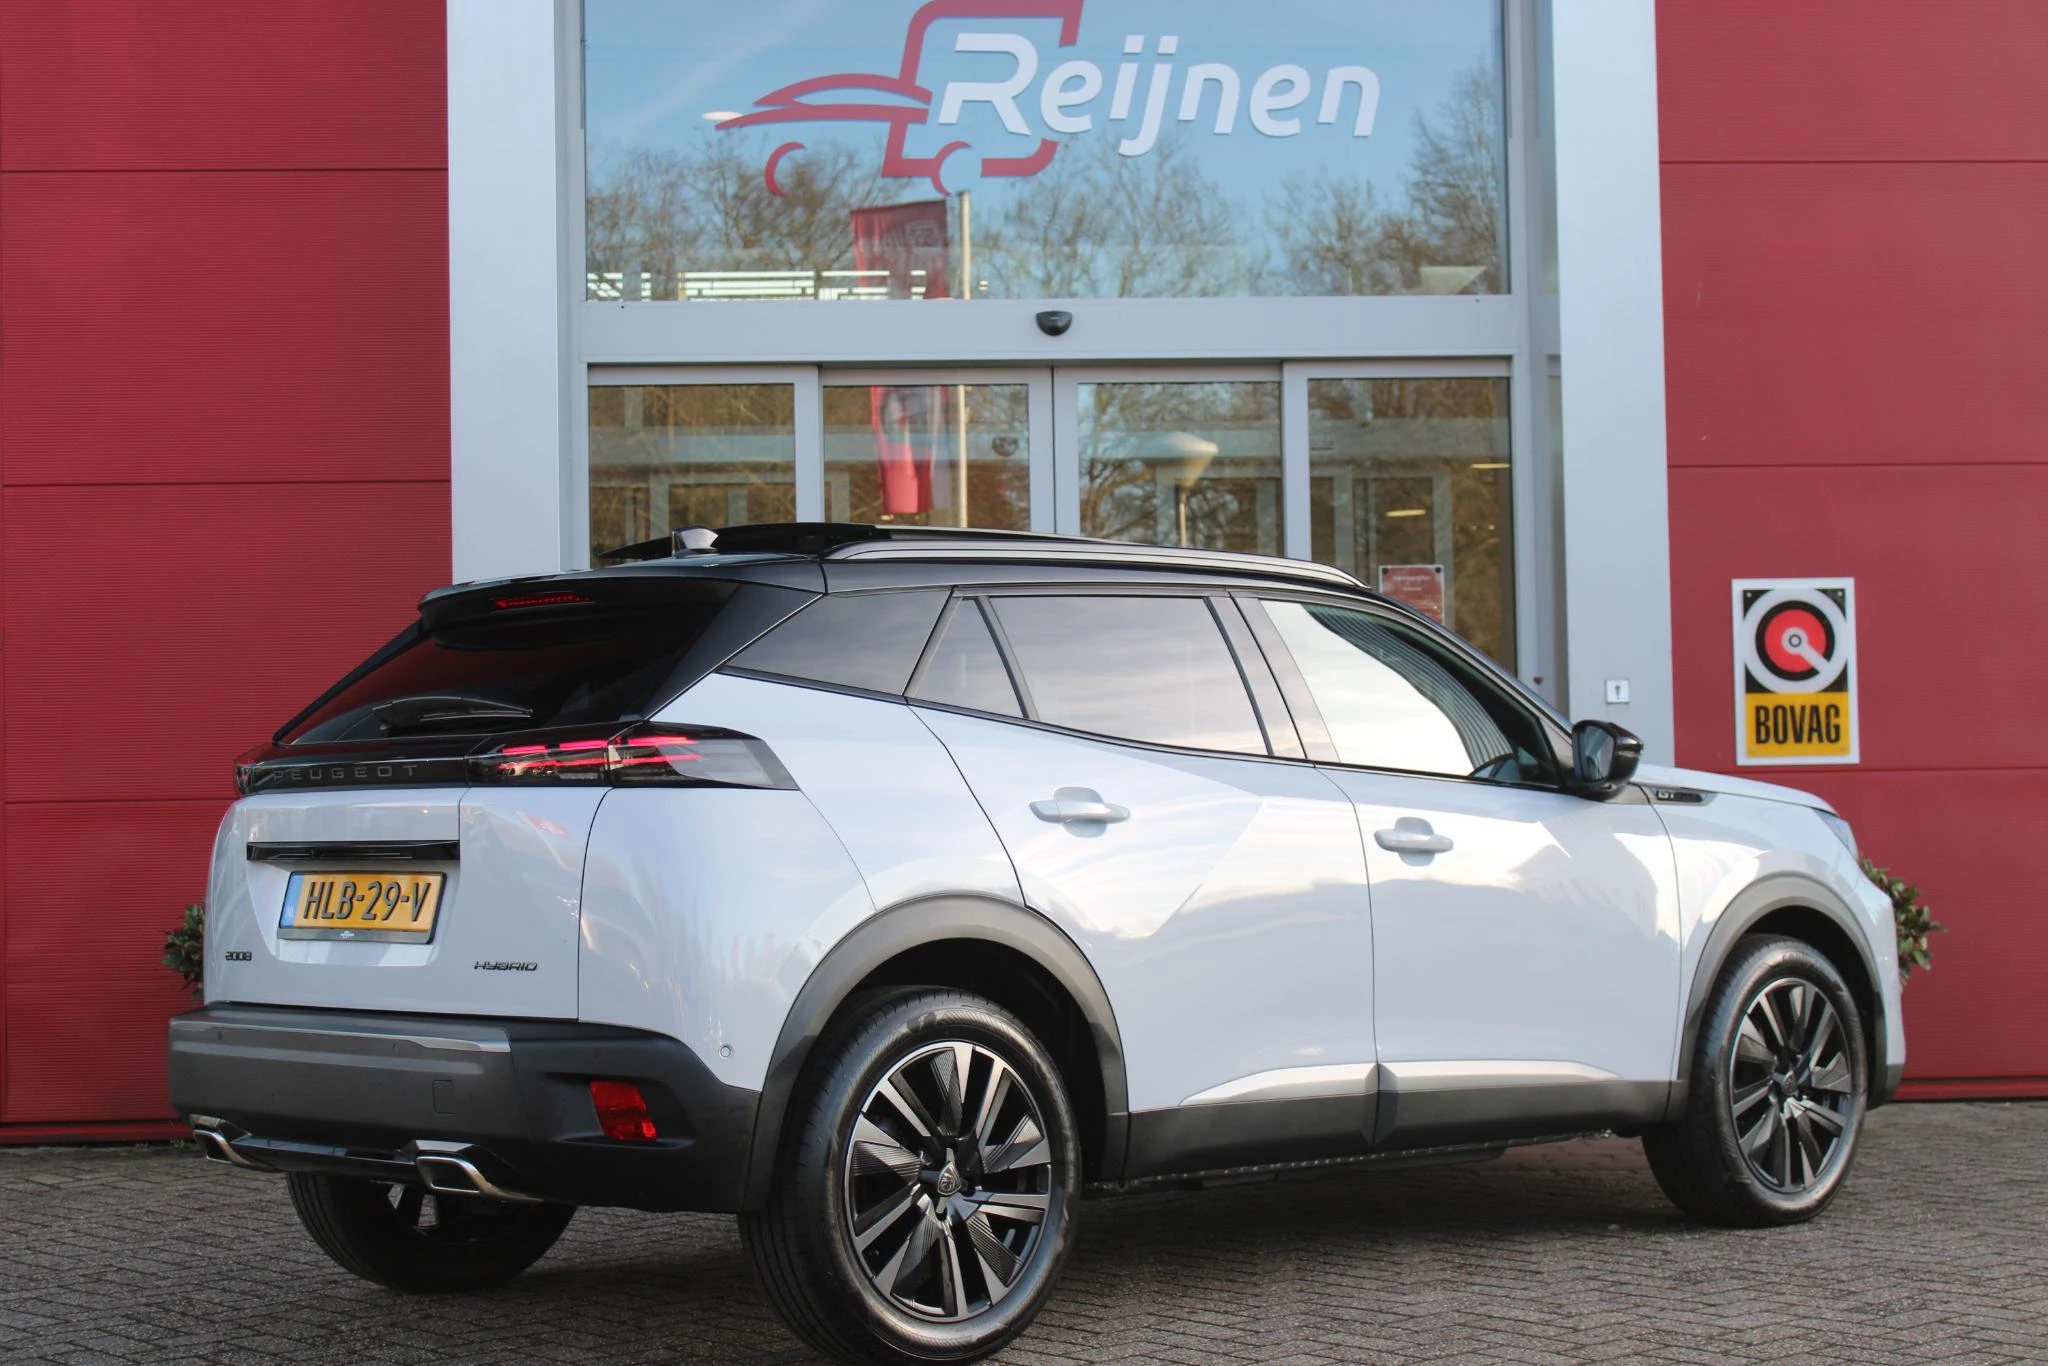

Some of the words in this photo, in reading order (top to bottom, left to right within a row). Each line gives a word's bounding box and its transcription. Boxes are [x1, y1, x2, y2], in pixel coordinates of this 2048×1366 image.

[937, 32, 1380, 156] Reijnen
[1755, 704, 1841, 744] BOVAG
[272, 764, 418, 784] PEUGEOT
[303, 881, 431, 921] HLB-29-V
[225, 951, 252, 961] 2008
[474, 961, 538, 971] HYBRID
